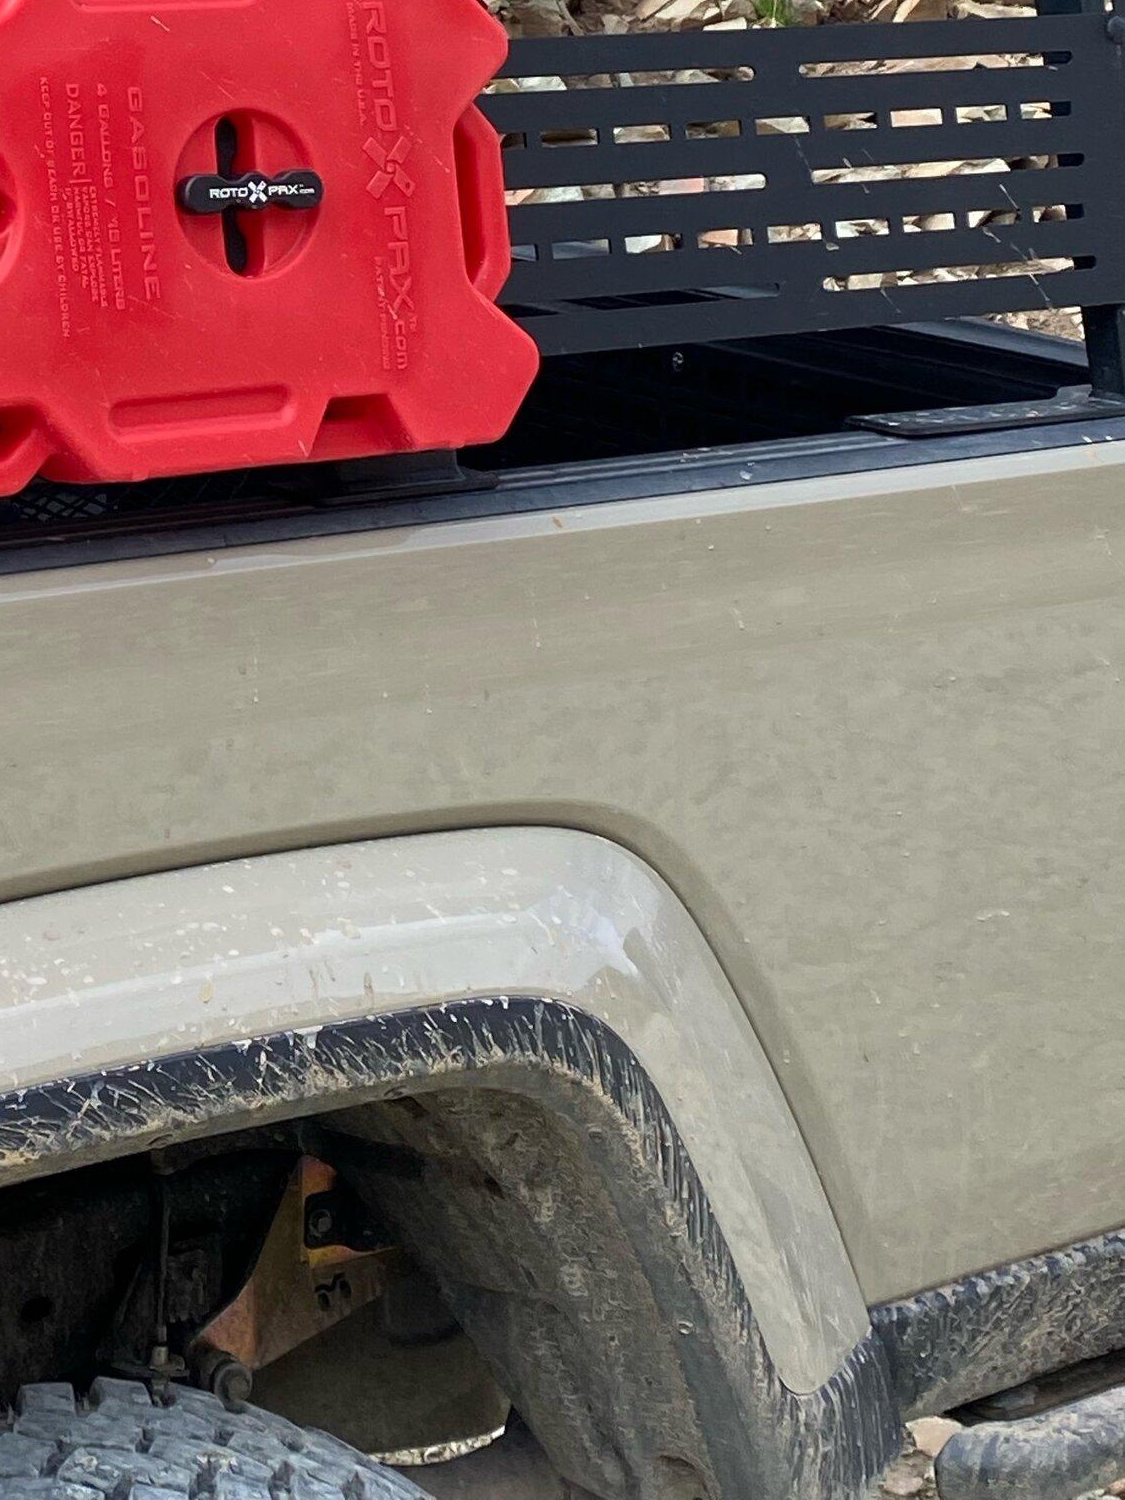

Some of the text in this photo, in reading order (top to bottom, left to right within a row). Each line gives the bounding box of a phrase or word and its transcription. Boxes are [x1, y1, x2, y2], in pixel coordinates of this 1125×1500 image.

[363, 1, 398, 131] ROTO
[39, 77, 51, 109] KEEP
[95, 83, 108, 97] 4
[42, 112, 53, 136] OUT
[64, 84, 87, 176] DANGER
[97, 105, 115, 188] GALLONS
[49, 206, 61, 222] OR
[126, 87, 160, 299] GASOLINE
[209, 187, 248, 199] ROTO
[52, 226, 63, 251] USE
[109, 248, 126, 310] LITERS
[56, 275, 71, 337] CHILDREN
